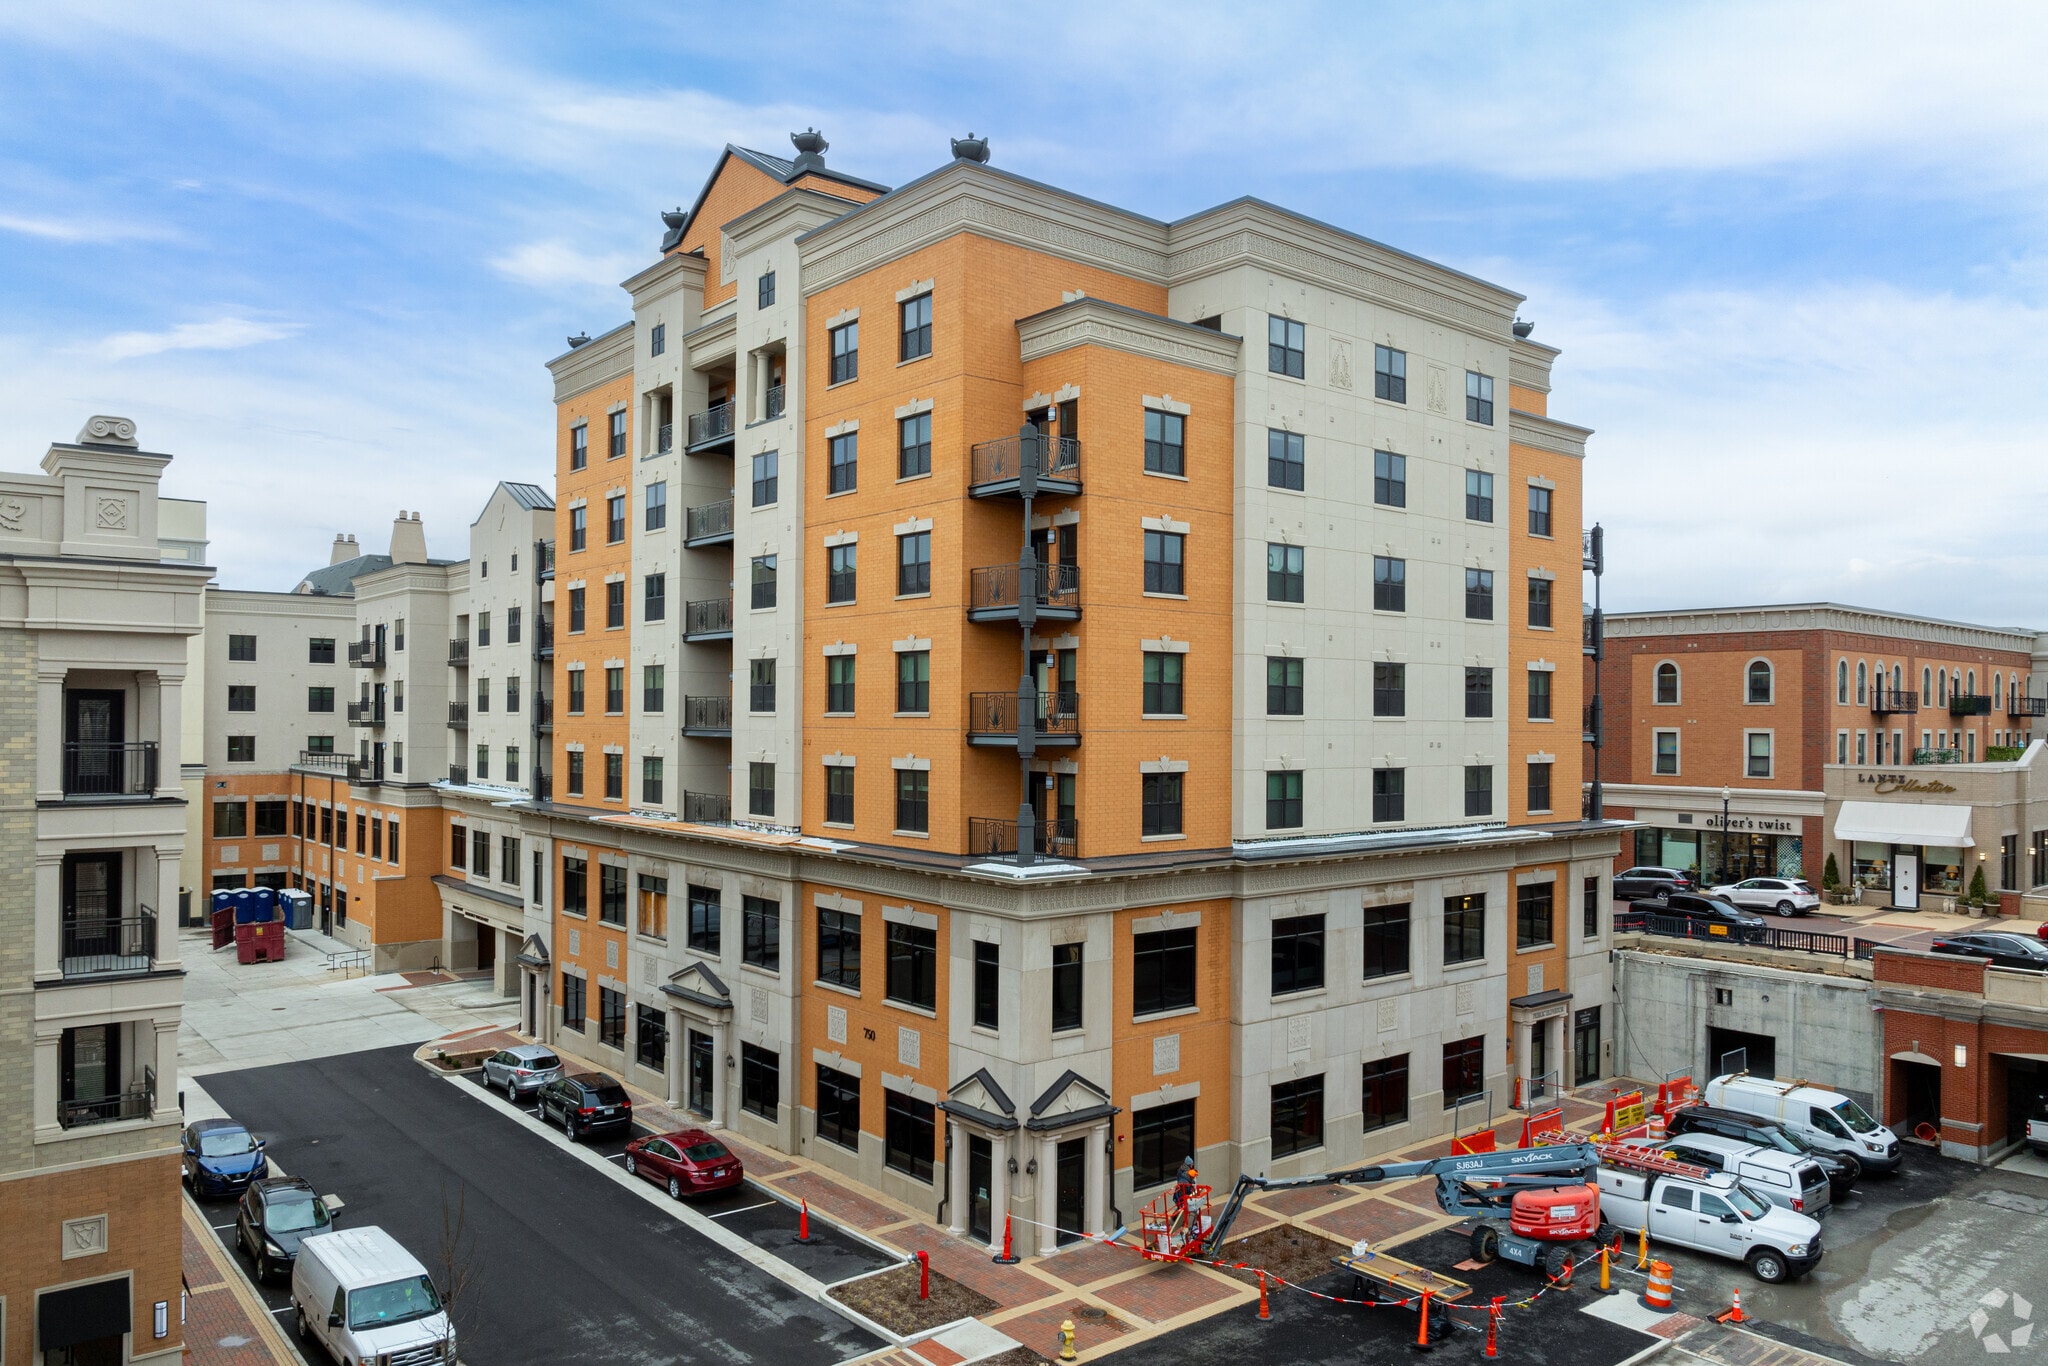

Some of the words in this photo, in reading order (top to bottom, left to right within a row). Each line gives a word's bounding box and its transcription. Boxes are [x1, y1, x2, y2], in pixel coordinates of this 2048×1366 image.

[1858, 773, 1906, 785] LANTZ
[1758, 818, 1792, 831] twist
[863, 1026, 876, 1042] 750
[1511, 1152, 1553, 1164] SKYJACK
[1456, 1160, 1483, 1170] SJ63AJ
[1549, 1227, 1580, 1235] SKYJACK
[1509, 1247, 1522, 1257] 4X4
